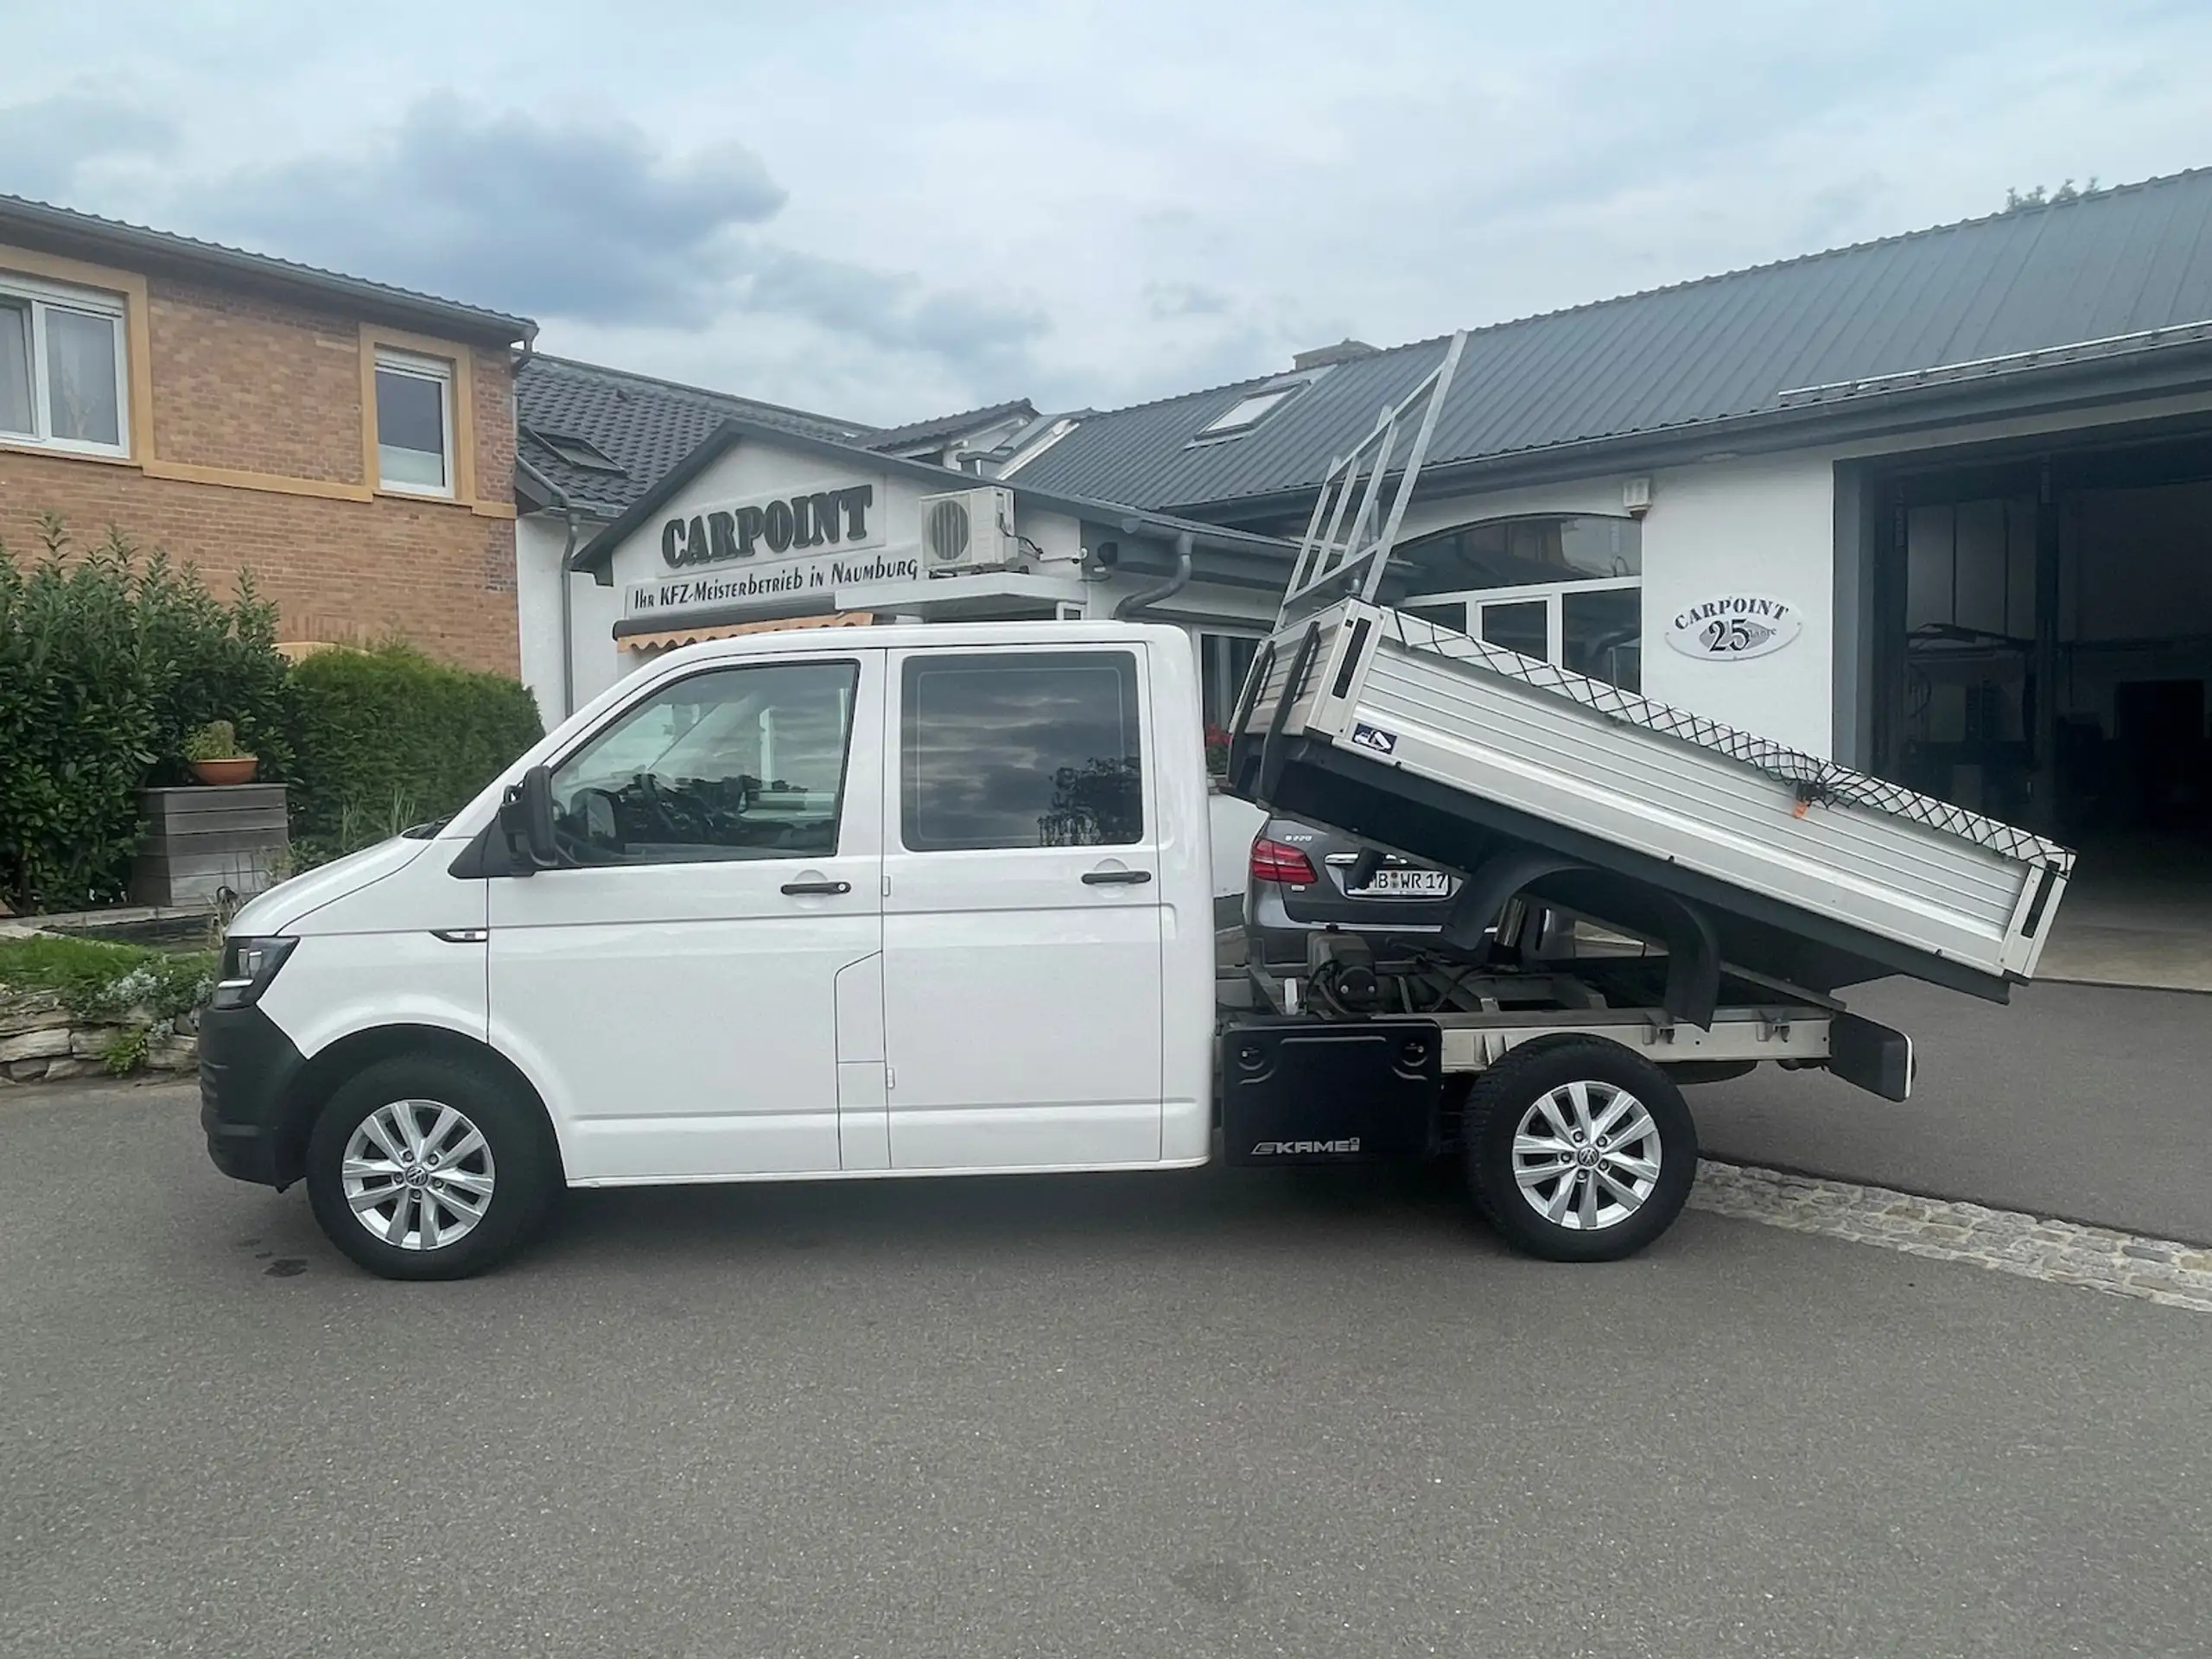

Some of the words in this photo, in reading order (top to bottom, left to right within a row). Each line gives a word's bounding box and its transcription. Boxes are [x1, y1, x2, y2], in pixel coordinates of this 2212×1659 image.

[662, 484, 873, 569] CARPOINT
[1674, 597, 1789, 631] CARPOINT
[1708, 618, 1750, 652] 25
[1400, 873, 1421, 889] WR
[1425, 873, 1446, 889] 17
